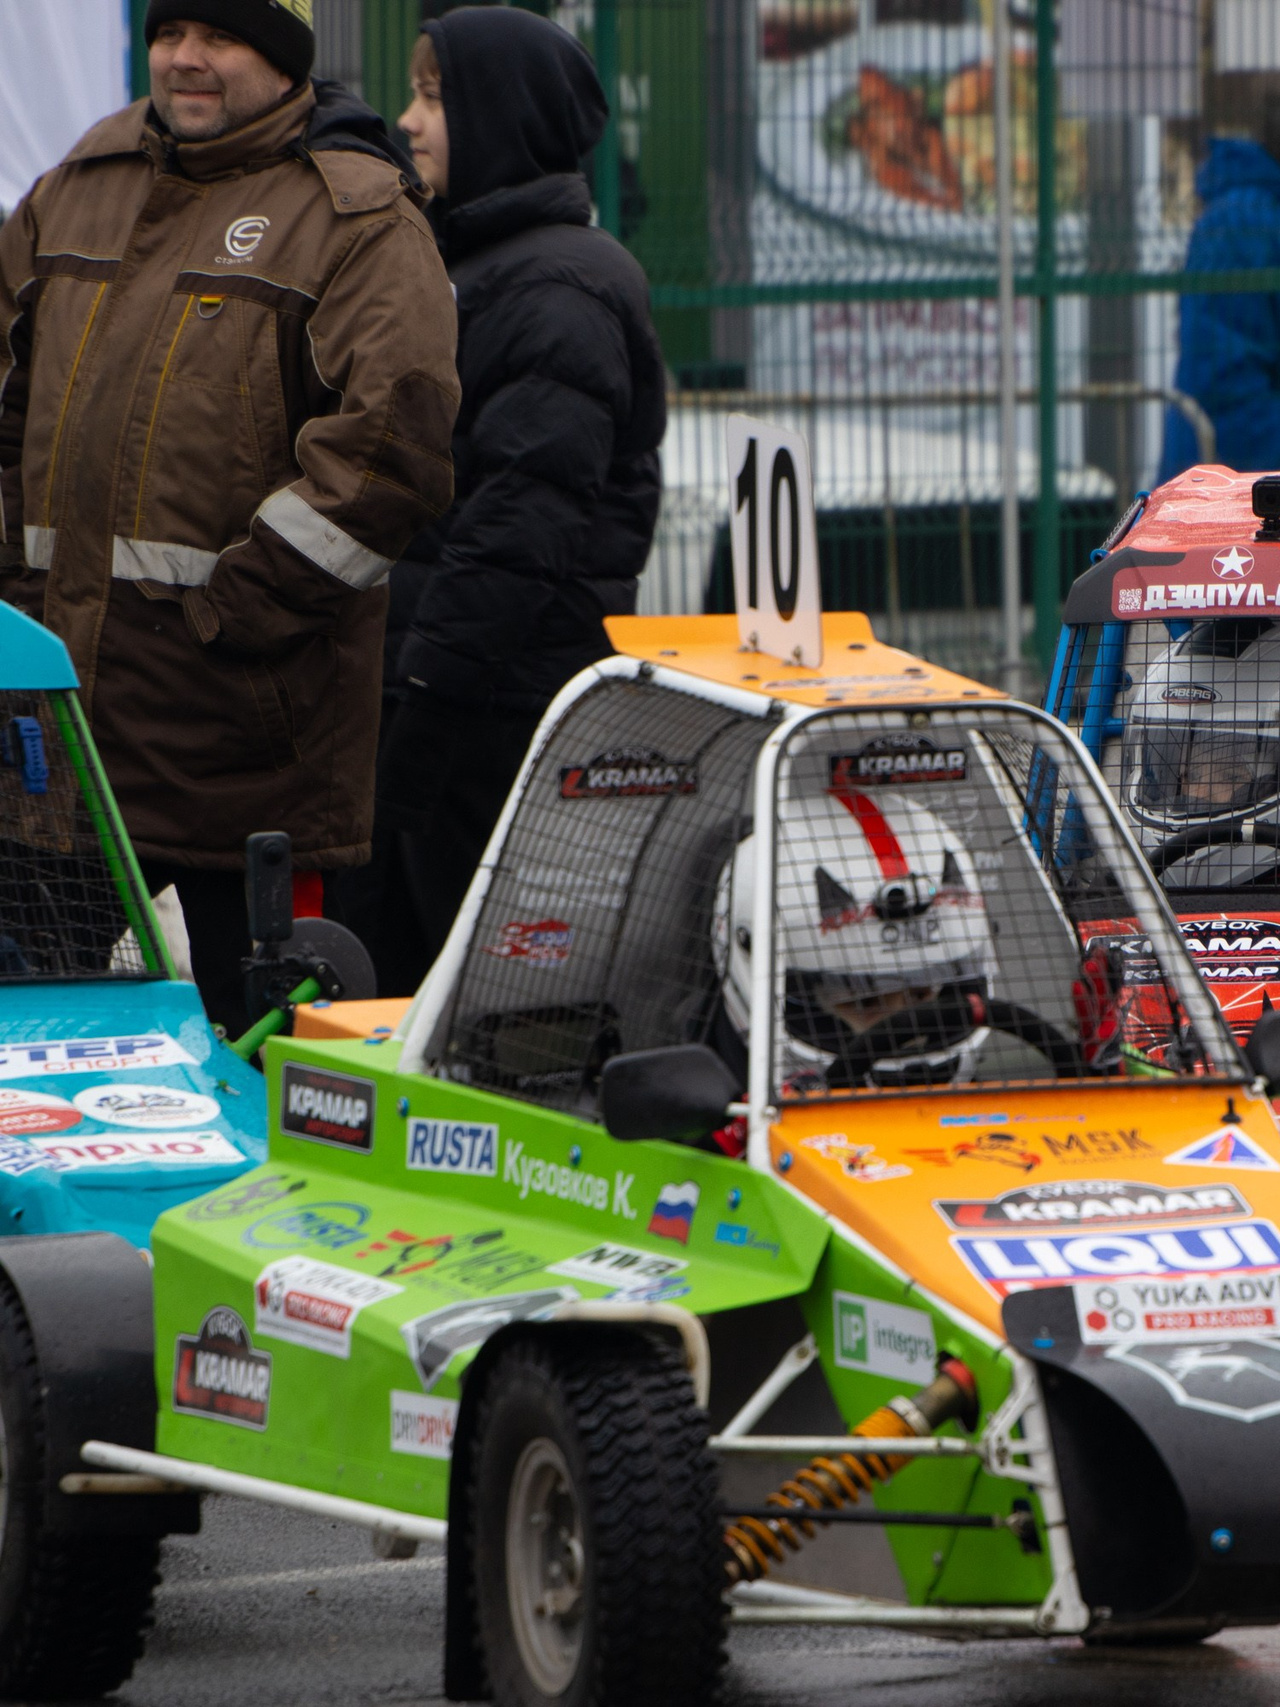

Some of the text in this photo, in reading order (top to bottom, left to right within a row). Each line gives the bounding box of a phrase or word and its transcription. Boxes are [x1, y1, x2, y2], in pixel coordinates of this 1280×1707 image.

[736, 437, 799, 622] 10
[858, 750, 966, 777] KRAMAR
[1178, 921, 1265, 933] КУБОК
[43, 1055, 164, 1073] СПОРТ
[288, 1083, 368, 1129] КРАМАР
[410, 1122, 495, 1171] RUSTA
[503, 1138, 638, 1220] Кузовков К.
[1001, 1189, 1236, 1222] KRAMAR
[973, 1223, 1279, 1279] LIQUI
[1132, 1279, 1275, 1307] YUKA ADV
[872, 1318, 935, 1364] integra
[1151, 1309, 1267, 1329] PRO RACING
[195, 1349, 270, 1403] KRAMAR
